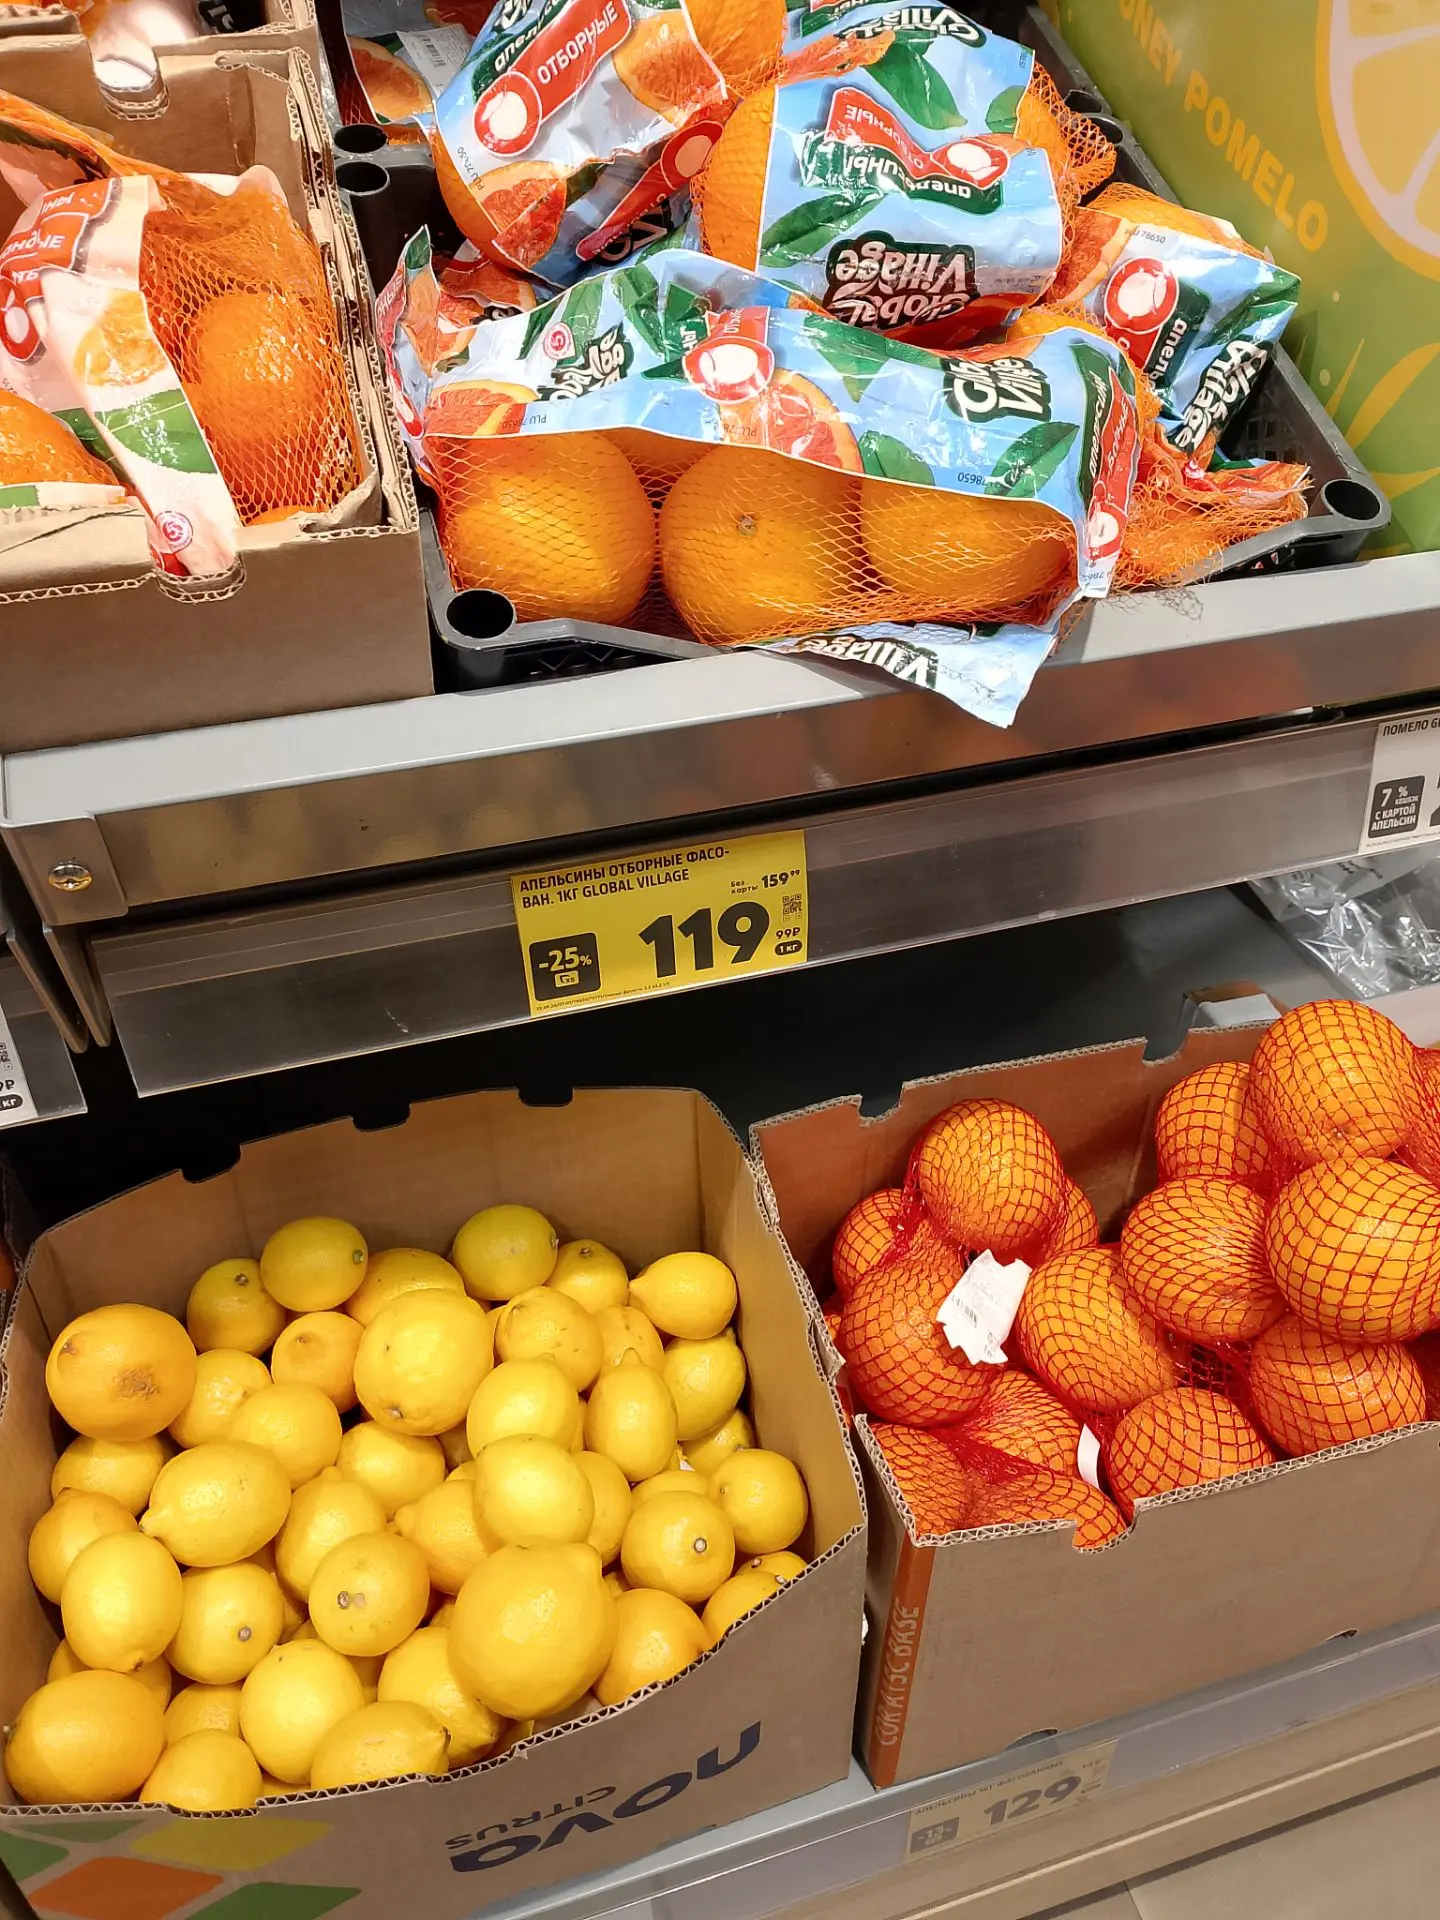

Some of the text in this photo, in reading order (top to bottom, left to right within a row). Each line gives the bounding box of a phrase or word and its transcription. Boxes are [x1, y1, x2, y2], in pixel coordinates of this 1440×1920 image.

[536, 1, 619, 84] ОТБОРНЫЕ
[1184, 69, 1328, 252] POMELO
[1140, 231, 1167, 244] 78650
[836, 241, 967, 292] Village
[1383, 719, 1428, 736] ПОМЕЛО
[1381, 788, 1392, 807] 7
[1382, 803, 1416, 819] КАРТОЙ
[1371, 815, 1416, 831] АПЕЛЬСИН
[519, 847, 730, 892] АПЕЛЬСИНЫ ОТБОРНЫЕ ФАСО-
[522, 868, 690, 909] ВАН. 1КГ GLOBAL VILLAGE
[538, 946, 592, 971] -25%
[639, 901, 770, 978] 119
[444, 1786, 616, 1850] CITRUS
[984, 1776, 1082, 1826] 129
